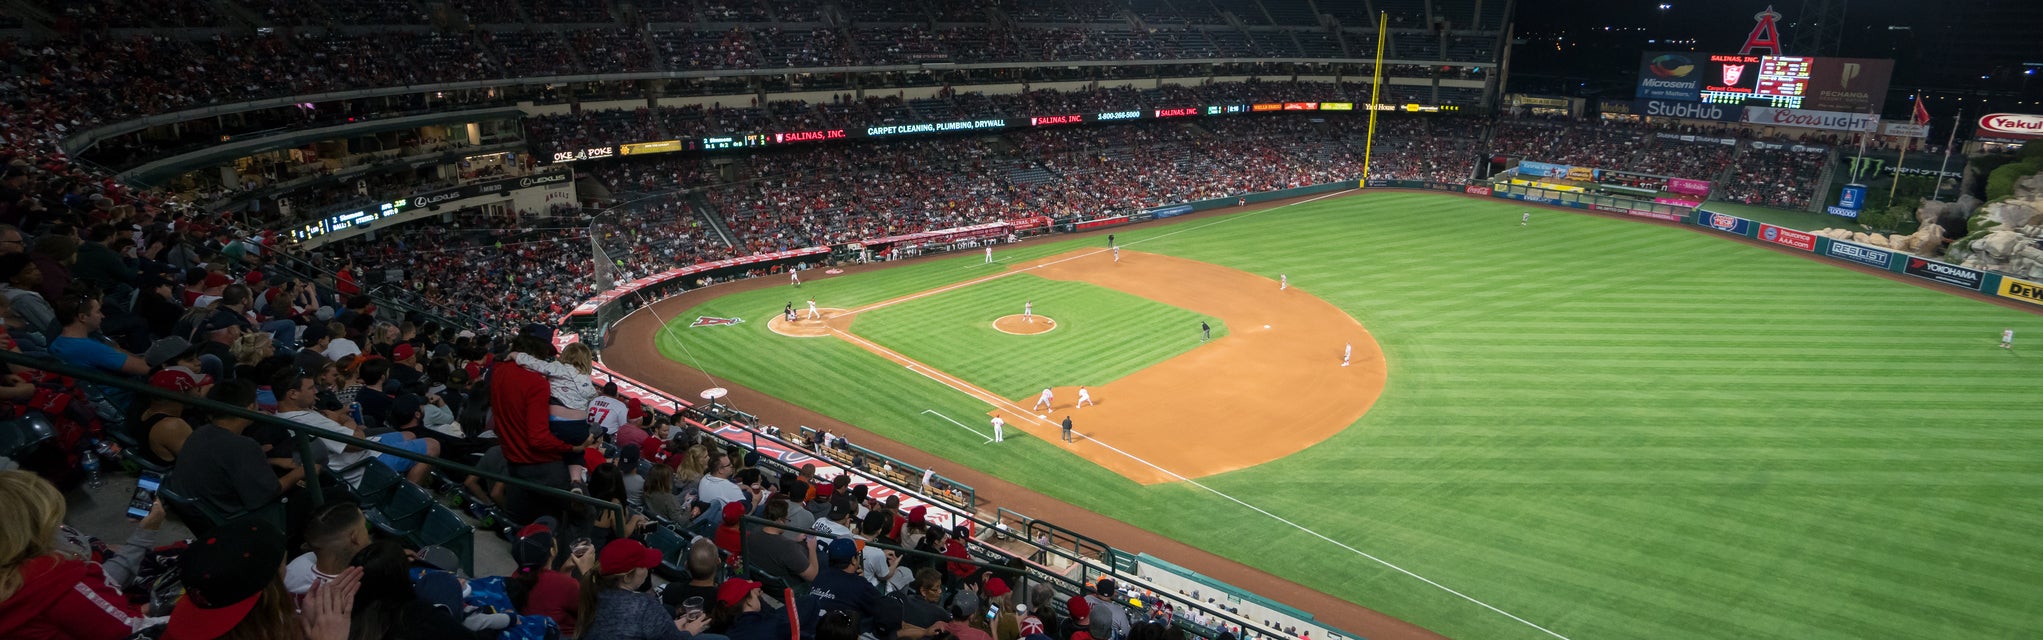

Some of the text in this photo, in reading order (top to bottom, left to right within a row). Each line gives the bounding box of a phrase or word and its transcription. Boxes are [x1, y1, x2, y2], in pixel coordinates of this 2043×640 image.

[1642, 78, 1696, 89] Microsemi
[1820, 90, 1868, 98] PECHANGA
[1160, 109, 1184, 117] SALINAS,
[1648, 100, 1722, 120] StubHub
[1038, 116, 1067, 125] SALINAS,
[1773, 108, 1868, 129] Coors LIGHT
[868, 120, 1005, 135] CARPET CLEANING, PLUMBING, DRYWALL
[786, 130, 846, 141] SALINAS, INC.
[1884, 166, 1963, 178] MONSTER
[532, 175, 566, 184] LEXUS
[427, 192, 460, 204] LEXUS
[546, 192, 568, 203] ANGELS
[1779, 238, 1809, 248] AAA.com
[1926, 262, 1976, 280] YOKOHAMA
[587, 407, 610, 424] 27
